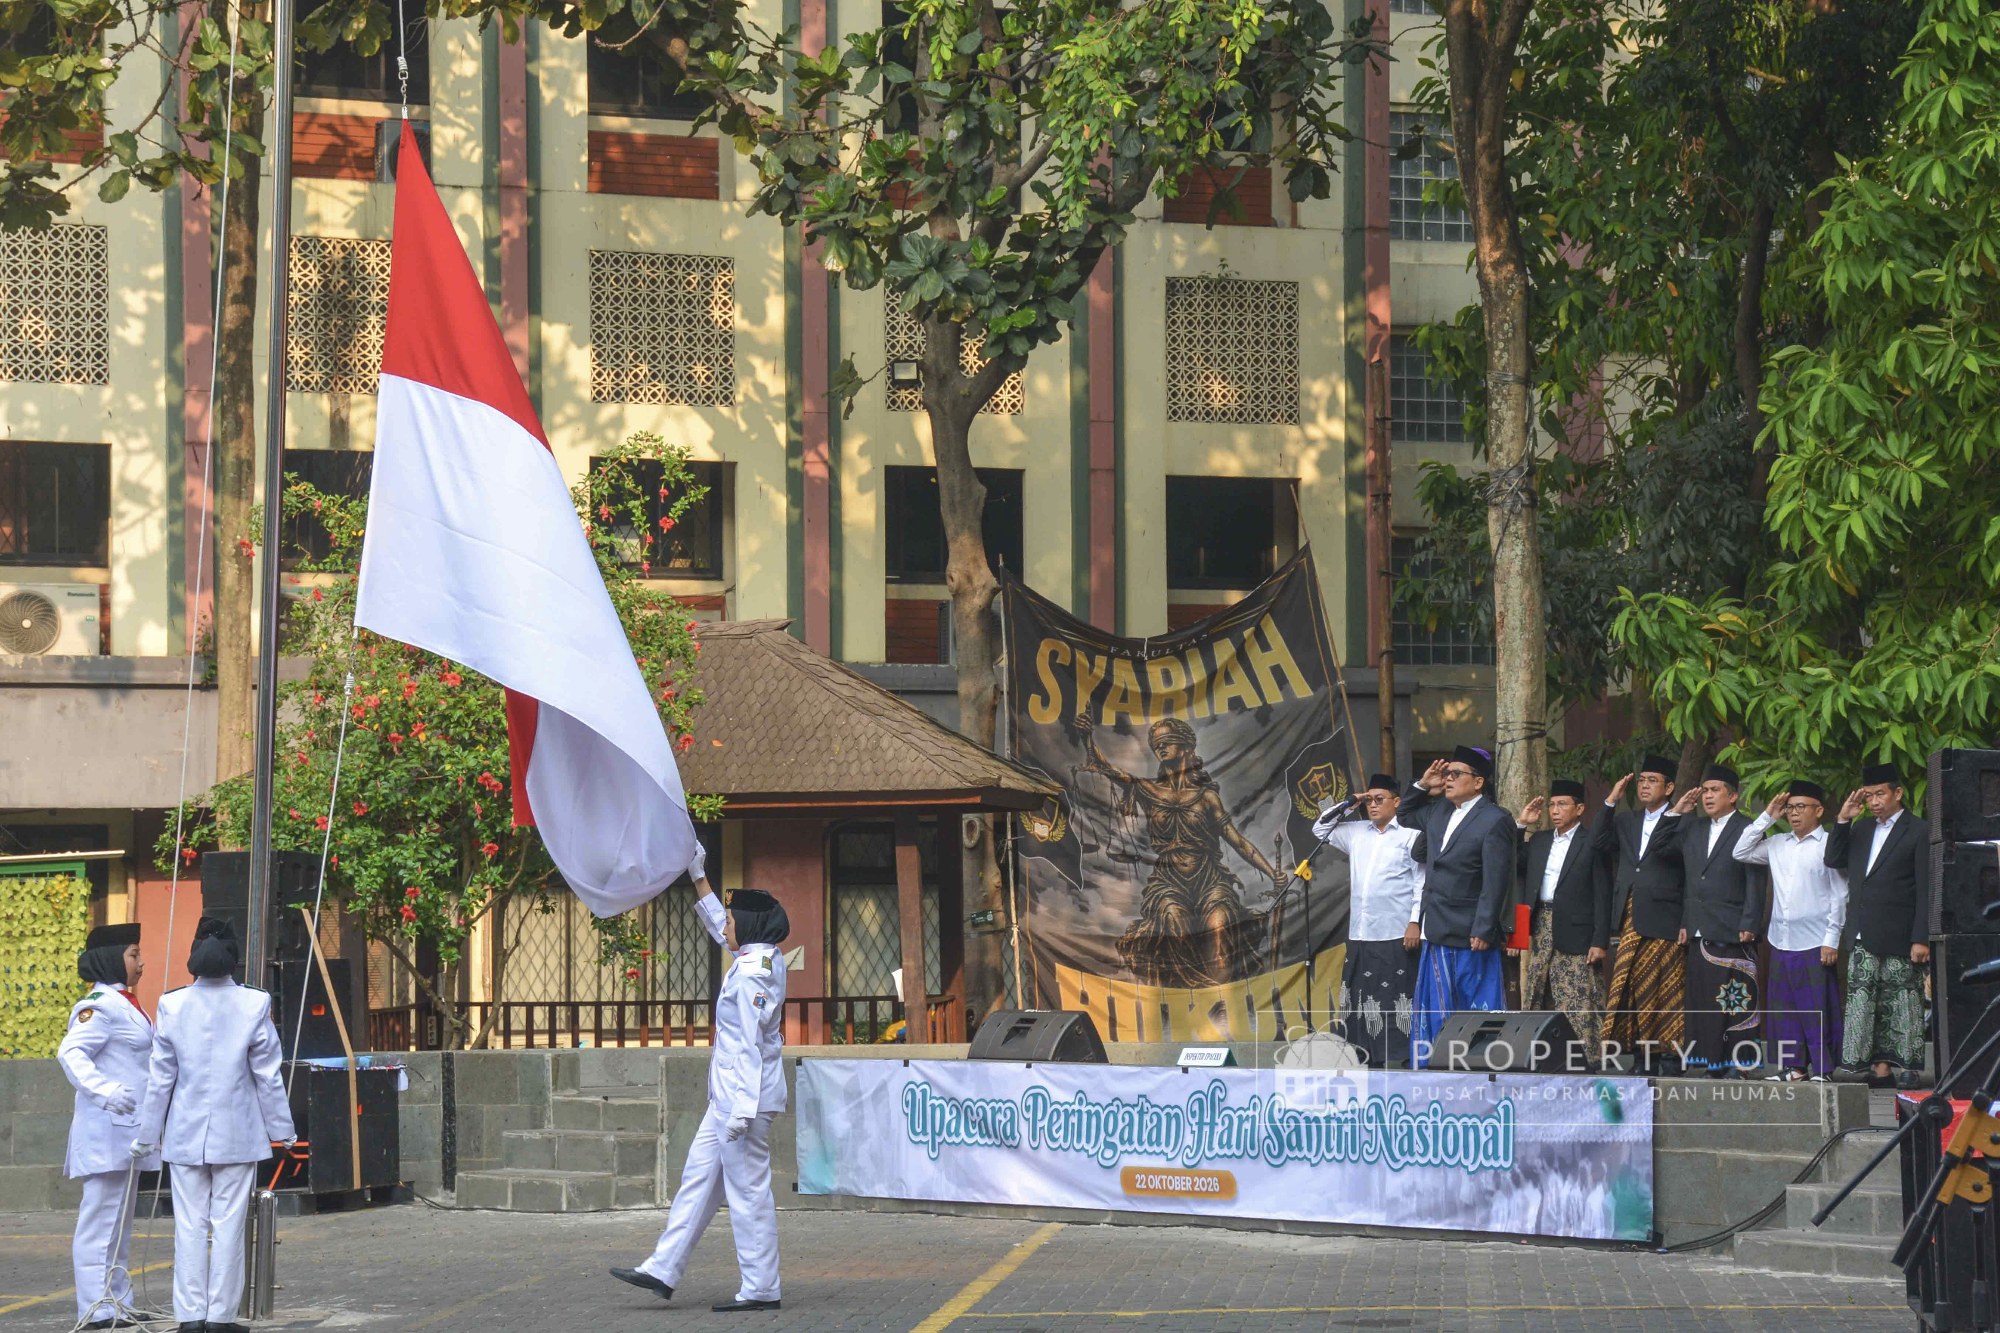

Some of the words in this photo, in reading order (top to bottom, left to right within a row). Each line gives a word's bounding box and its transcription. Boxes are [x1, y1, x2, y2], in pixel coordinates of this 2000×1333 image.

[1028, 613, 1314, 725] SYARIAH
[903, 1082, 1020, 1158] Upacara
[1022, 1086, 1183, 1167] Peringatan
[1182, 1080, 1261, 1167] Hari
[1263, 1092, 1360, 1167] Santri
[1363, 1094, 1514, 1174] Nasional
[1135, 1173, 1146, 1189] 22
[1148, 1174, 1192, 1191] OKTOBER
[1194, 1176, 1220, 1192] 2026
